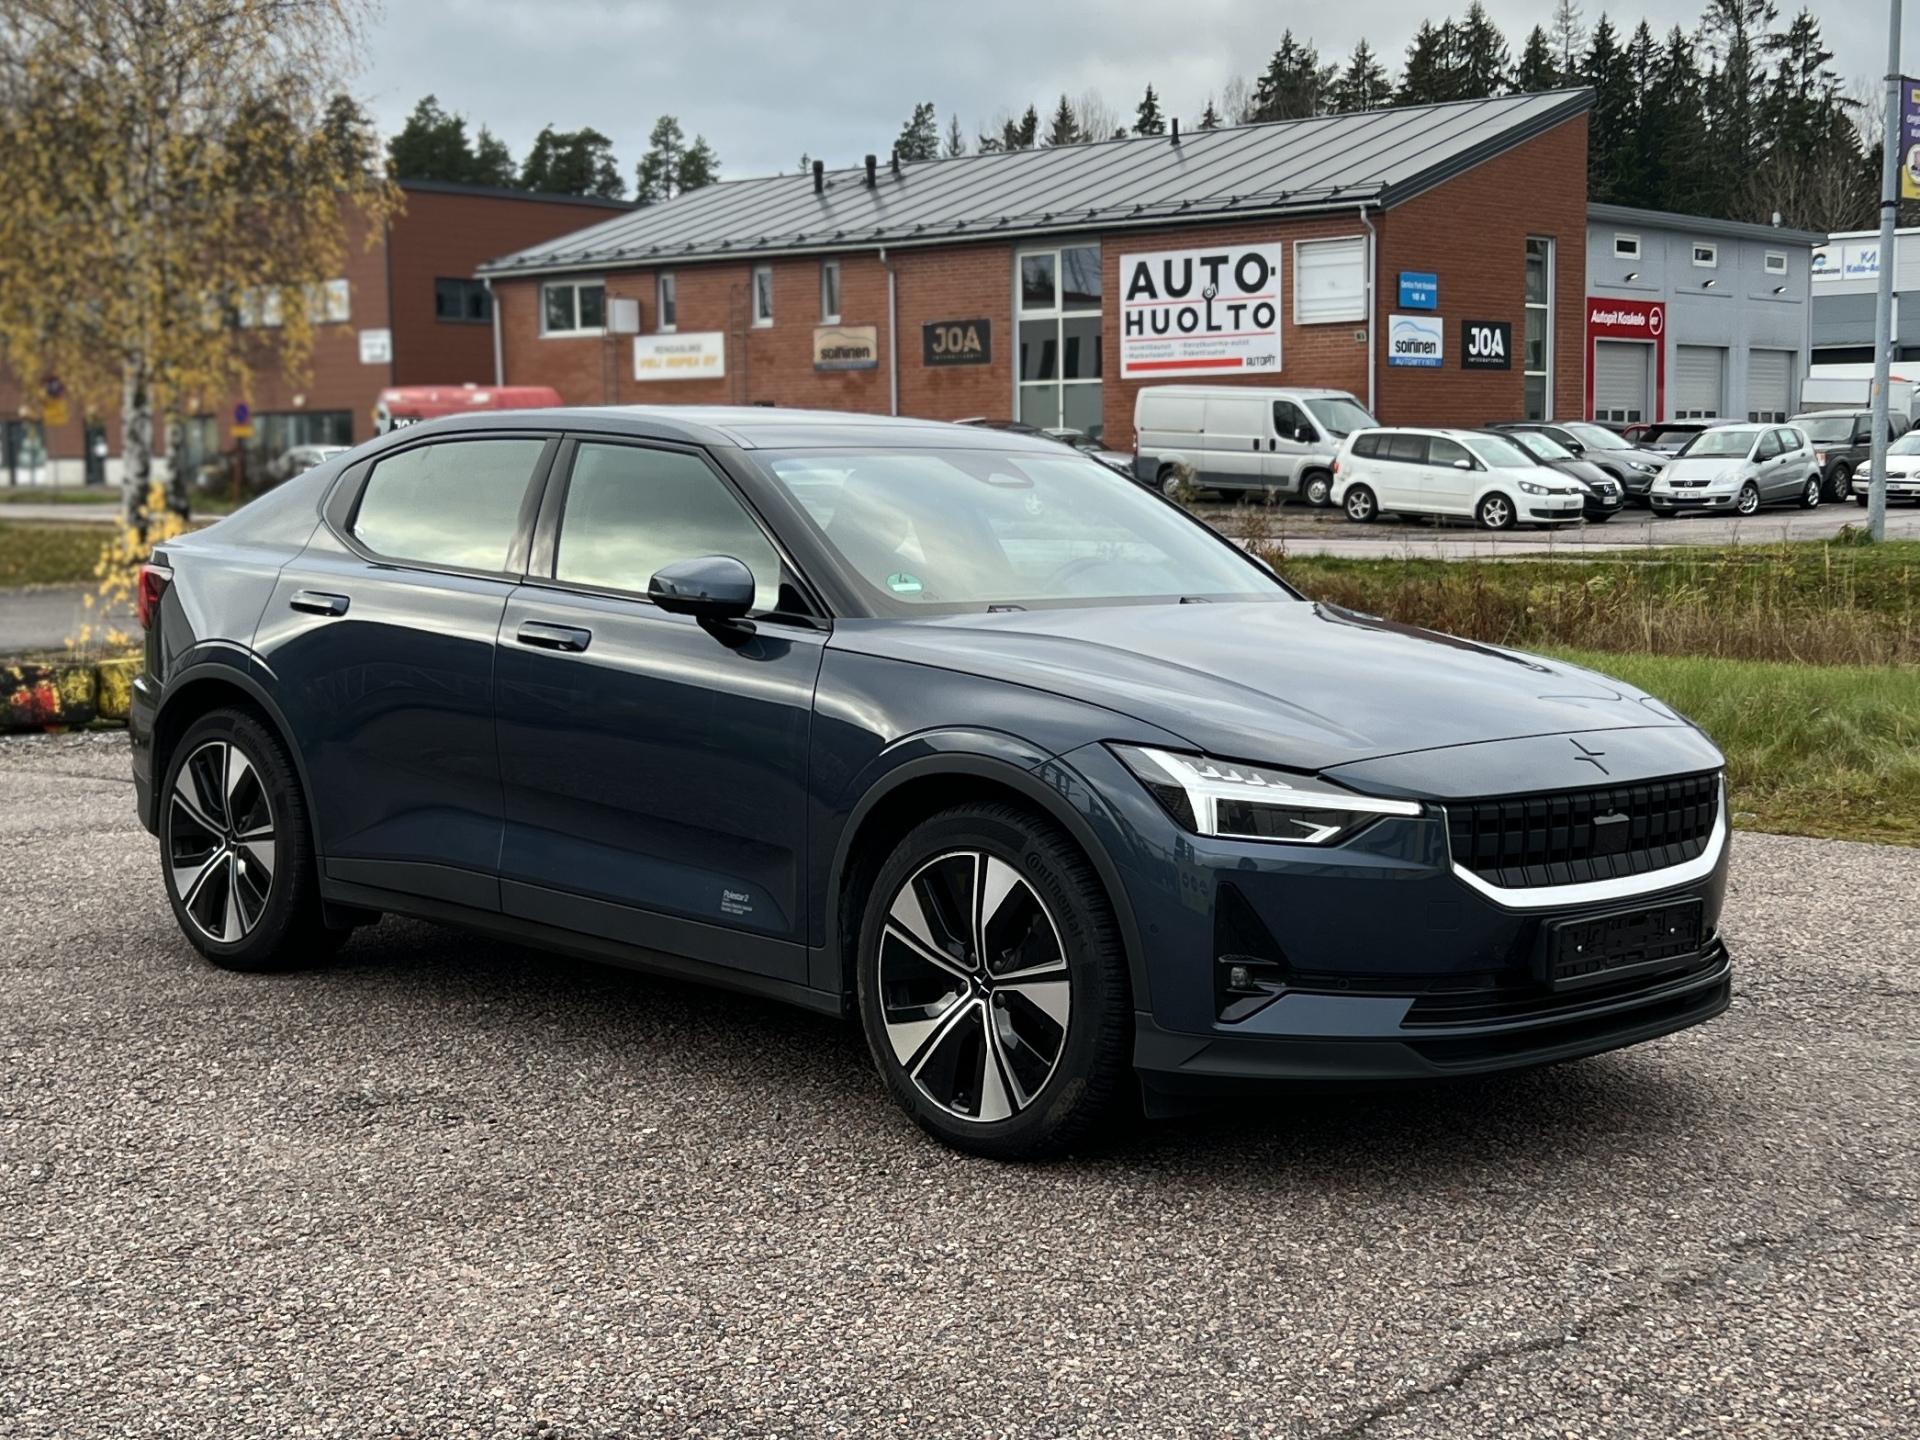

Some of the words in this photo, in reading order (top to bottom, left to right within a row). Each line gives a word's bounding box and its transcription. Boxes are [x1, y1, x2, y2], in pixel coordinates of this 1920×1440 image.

[1125, 302, 1276, 336] HUOLTO
[932, 325, 982, 354] JOA
[1395, 340, 1437, 354] soininen
[1469, 327, 1505, 357] JOA
